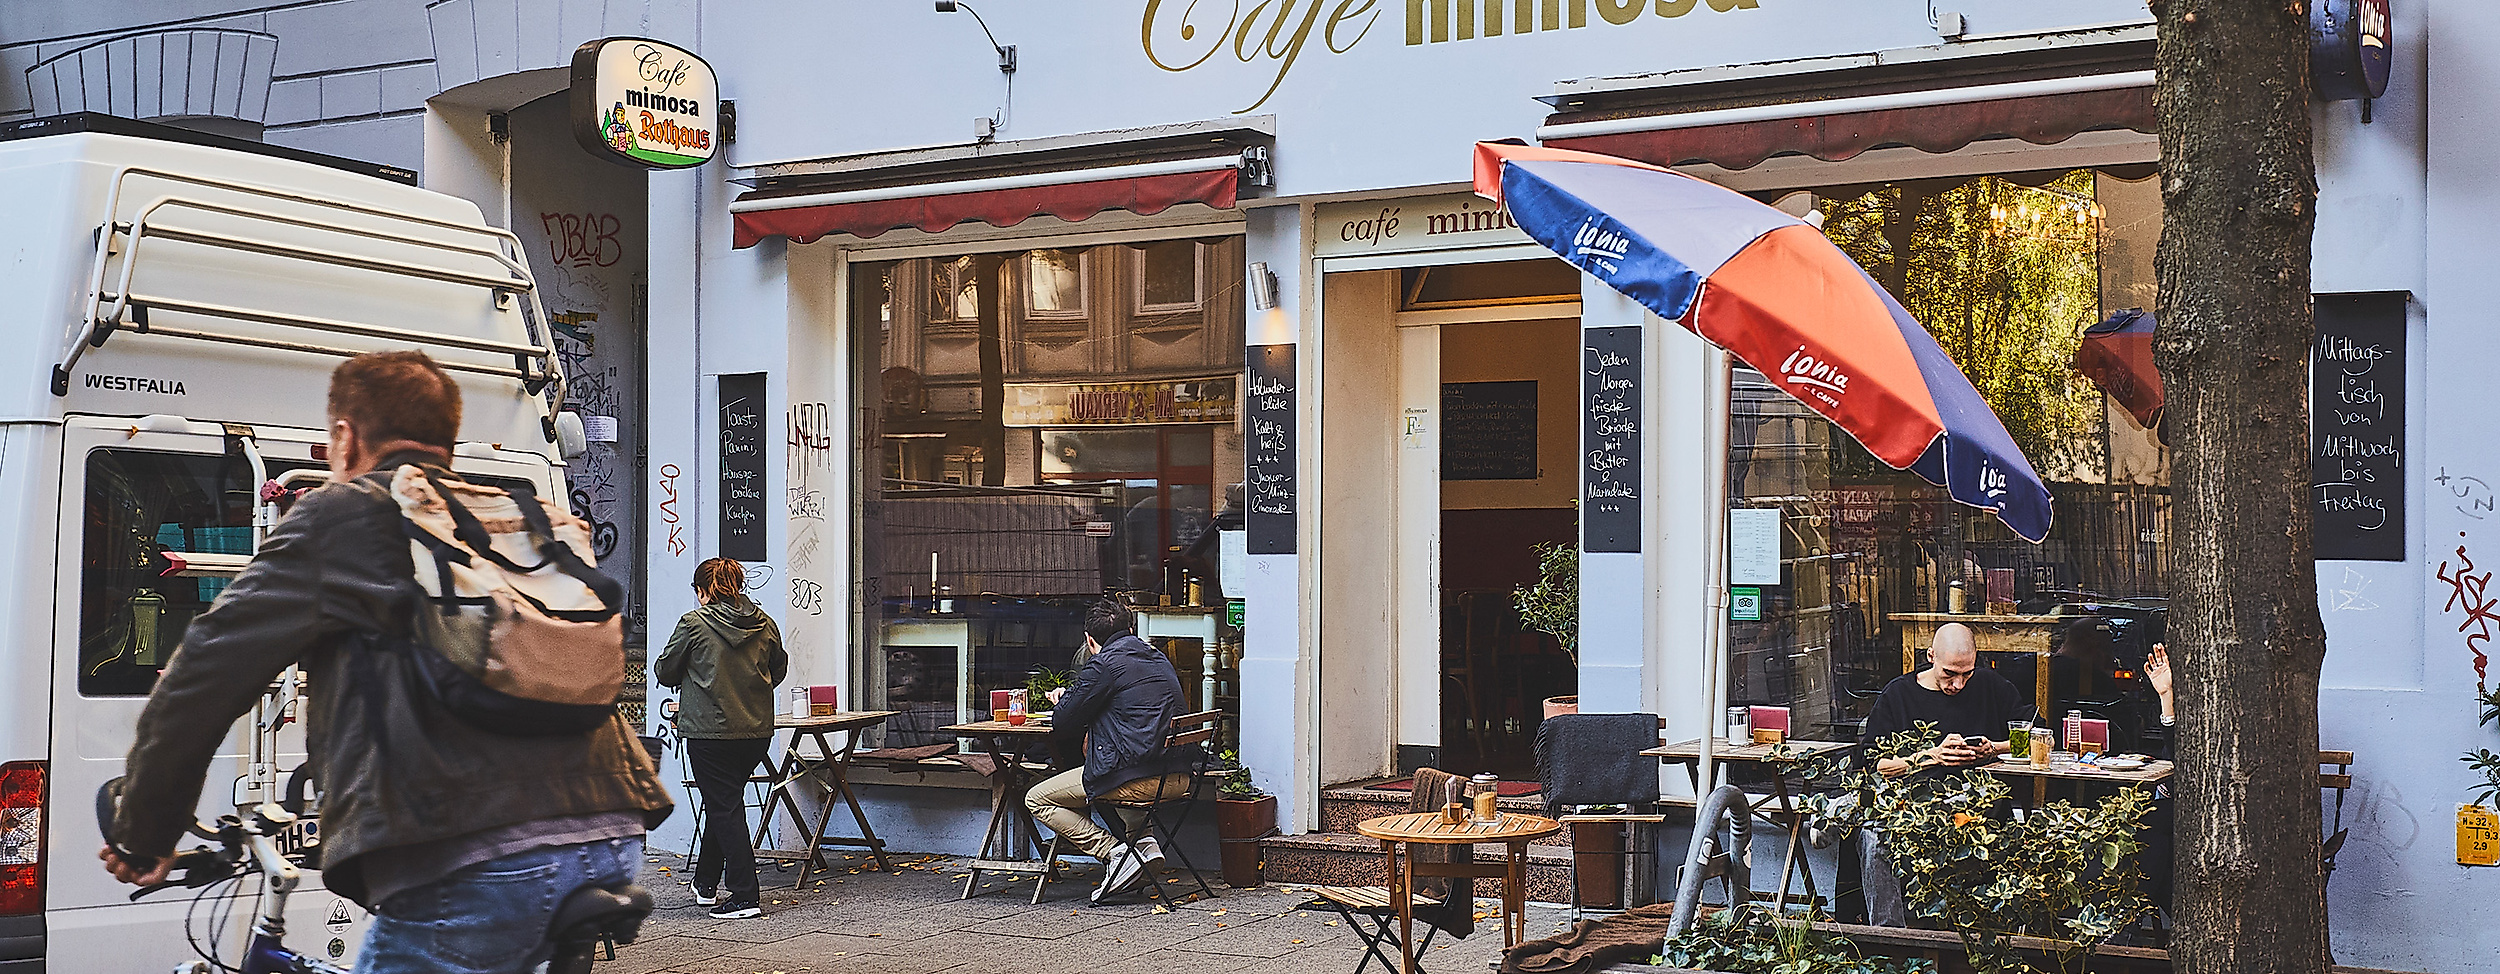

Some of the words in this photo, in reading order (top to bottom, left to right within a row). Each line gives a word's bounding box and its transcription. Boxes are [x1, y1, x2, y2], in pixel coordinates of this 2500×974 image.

[633, 44, 692, 93] Café
[626, 86, 700, 117] mimosa
[638, 110, 711, 151] Rothaus
[1340, 207, 1400, 246] café
[1574, 216, 1630, 254] ionia
[1586, 347, 1630, 375] Jeden
[1780, 344, 1848, 388] ionia
[2317, 334, 2392, 376] Mittags-
[85, 374, 186, 395] WESTFALIA
[1248, 366, 1294, 397] Holunder-
[1601, 371, 1633, 399] Morgen
[1590, 394, 1631, 421] frische
[2337, 374, 2384, 419] tisch
[721, 397, 758, 428] Toast,
[1595, 415, 1637, 439] Brioche
[2334, 409, 2372, 426] von
[720, 429, 758, 456] Panini,
[1260, 433, 1287, 454] heiß
[1605, 437, 1621, 452] mit
[2321, 434, 2399, 468] Mittwoch
[1588, 449, 1629, 471] Butter
[2341, 459, 2376, 482] bis
[725, 502, 756, 526] Kuchen
[2314, 482, 2387, 530] Freitag
